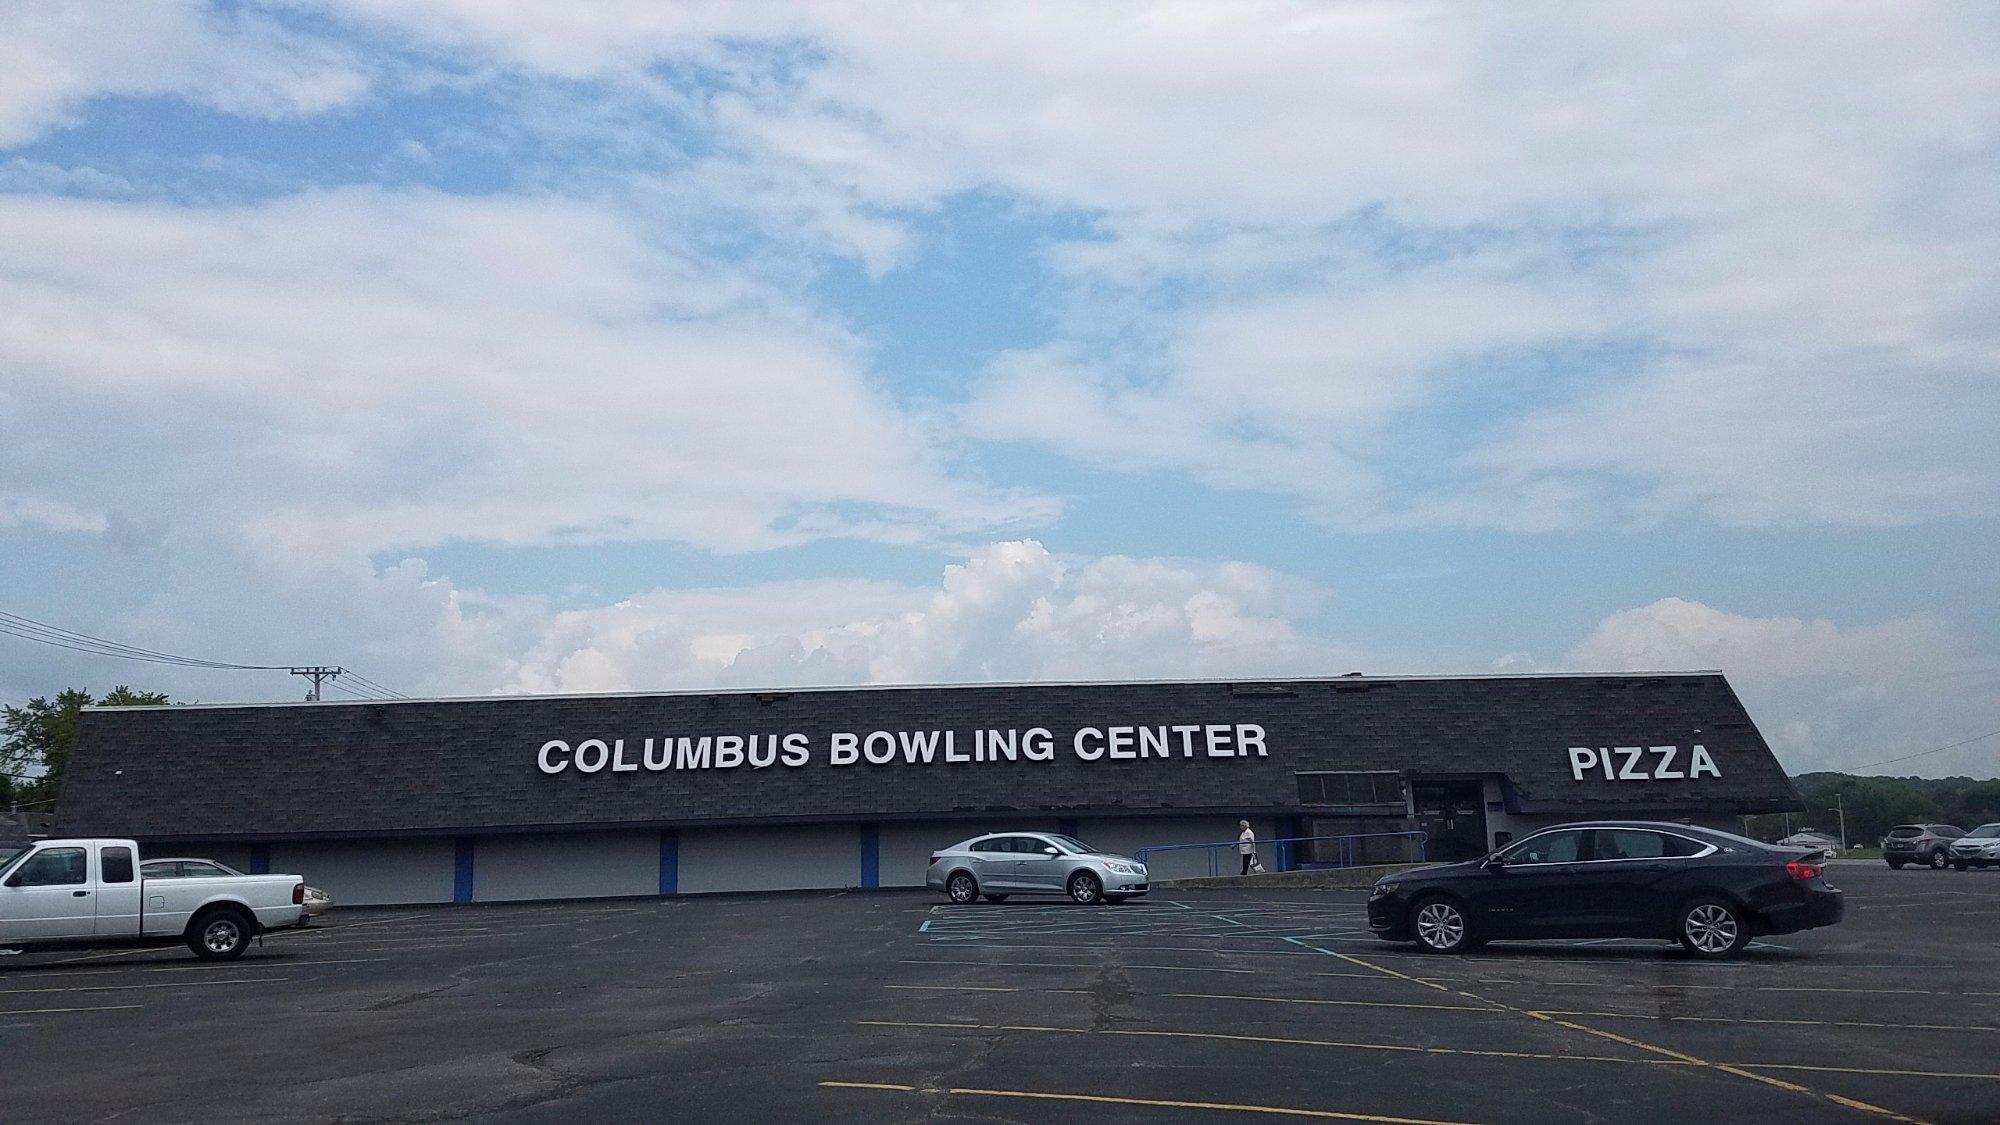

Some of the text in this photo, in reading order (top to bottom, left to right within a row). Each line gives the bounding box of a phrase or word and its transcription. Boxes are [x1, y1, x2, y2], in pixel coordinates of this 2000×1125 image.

[537, 723, 1269, 774] COLUMBUS BOWLING CENTER
[1568, 745, 1722, 781] PIZZA
